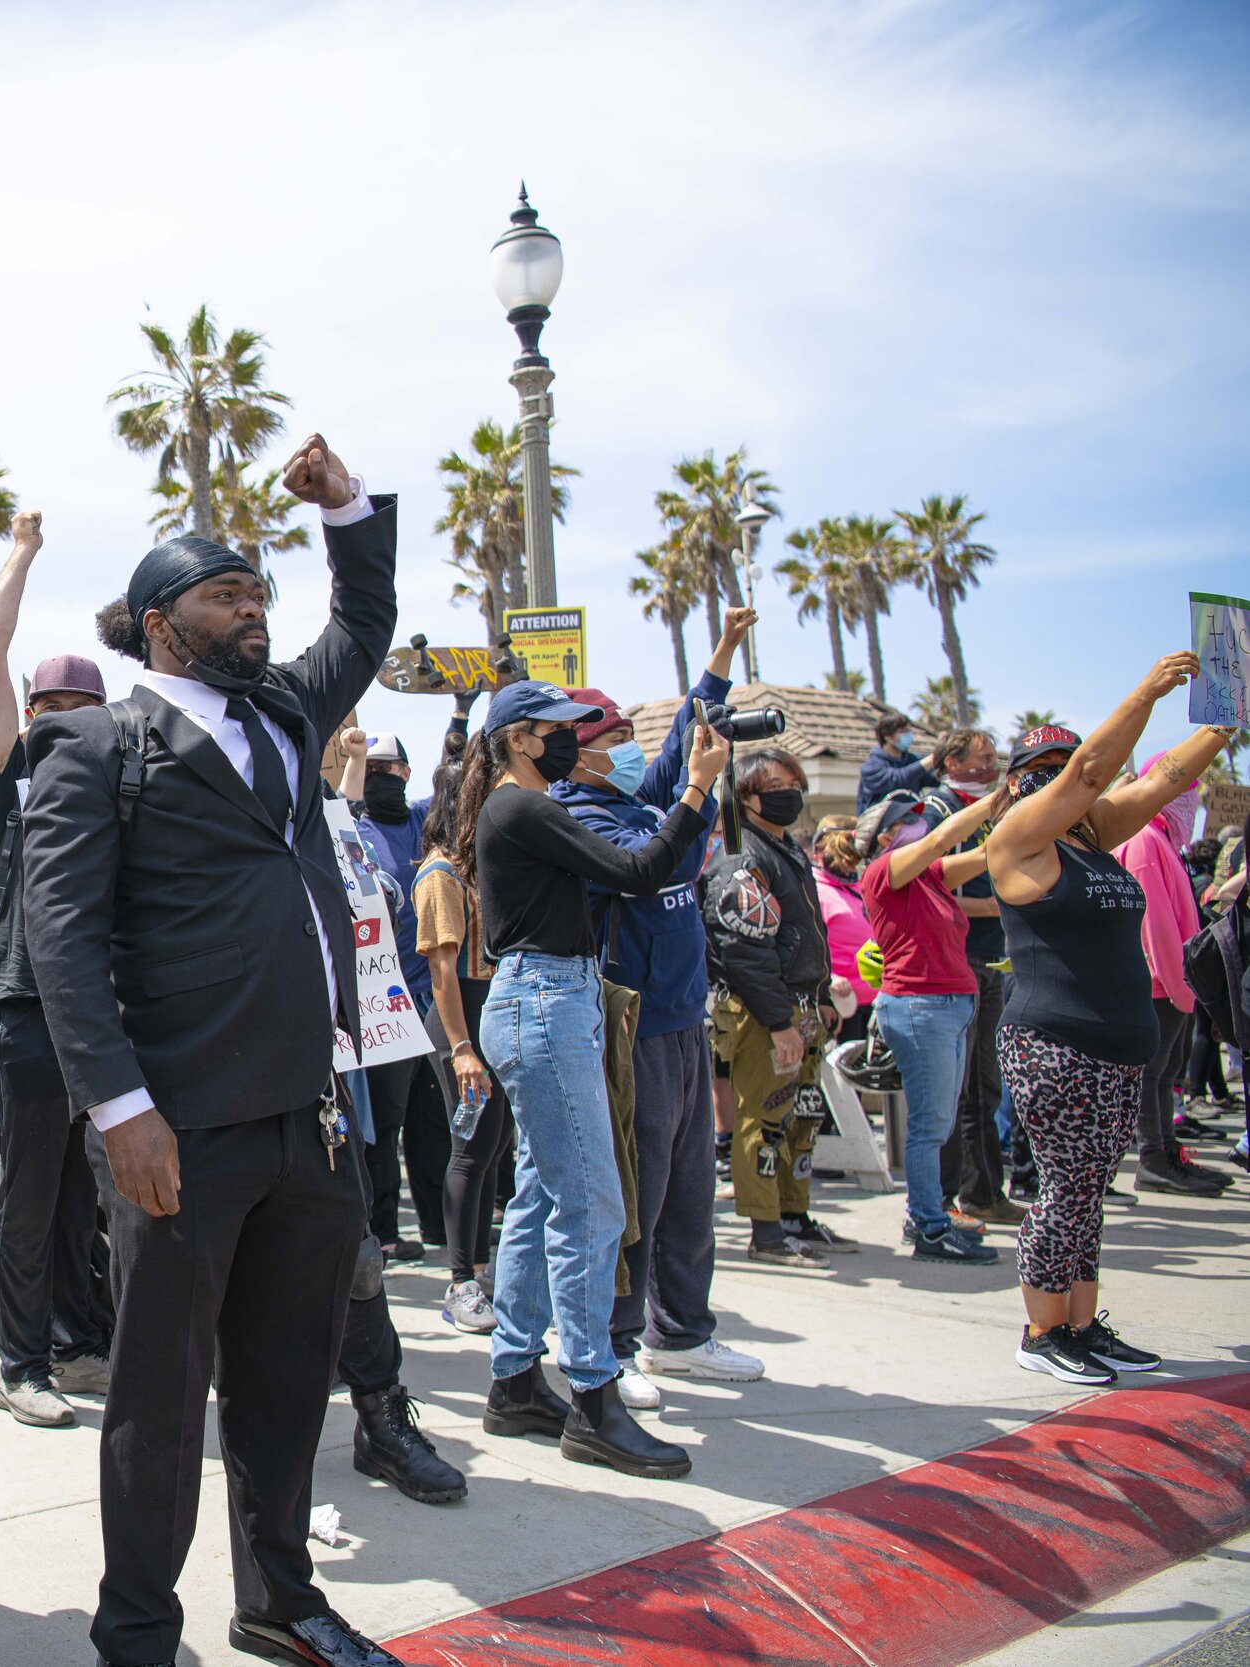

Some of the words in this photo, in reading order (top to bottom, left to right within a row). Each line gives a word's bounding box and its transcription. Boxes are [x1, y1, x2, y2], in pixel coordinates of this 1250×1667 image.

[510, 614, 579, 630] ATTENTION
[511, 639, 535, 647] SOCIAL
[537, 636, 579, 646] DISTANCING
[1210, 655, 1242, 679] THE
[1206, 678, 1237, 701] KKK
[1085, 871, 1104, 882] Be
[1105, 873, 1125, 883] the
[1085, 884, 1111, 899] you
[1114, 883, 1136, 895] wish
[1100, 896, 1116, 909] in
[1120, 896, 1134, 909] the
